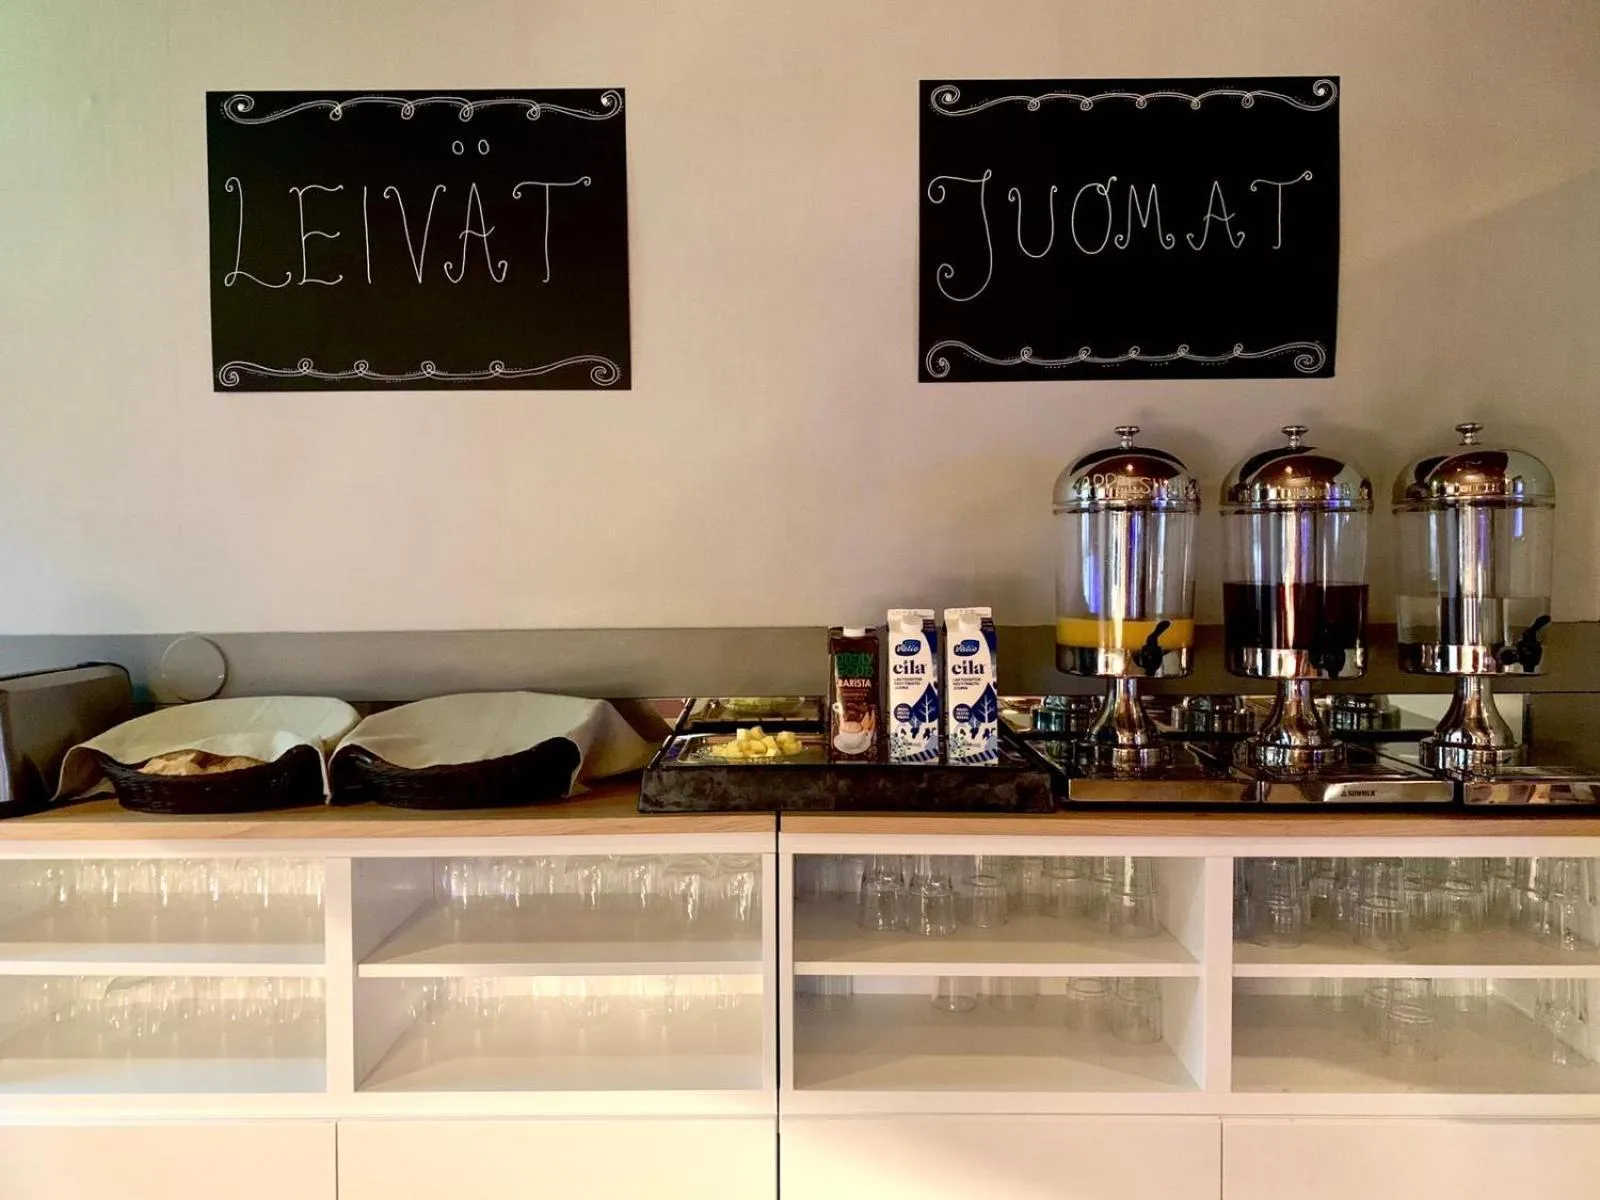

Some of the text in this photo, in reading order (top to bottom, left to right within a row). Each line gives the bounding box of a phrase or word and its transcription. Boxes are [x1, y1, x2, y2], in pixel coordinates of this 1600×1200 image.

[225, 139, 592, 288] LEIVÄT
[928, 169, 1313, 302] JUOMAT
[836, 678, 872, 688] BARISTA
